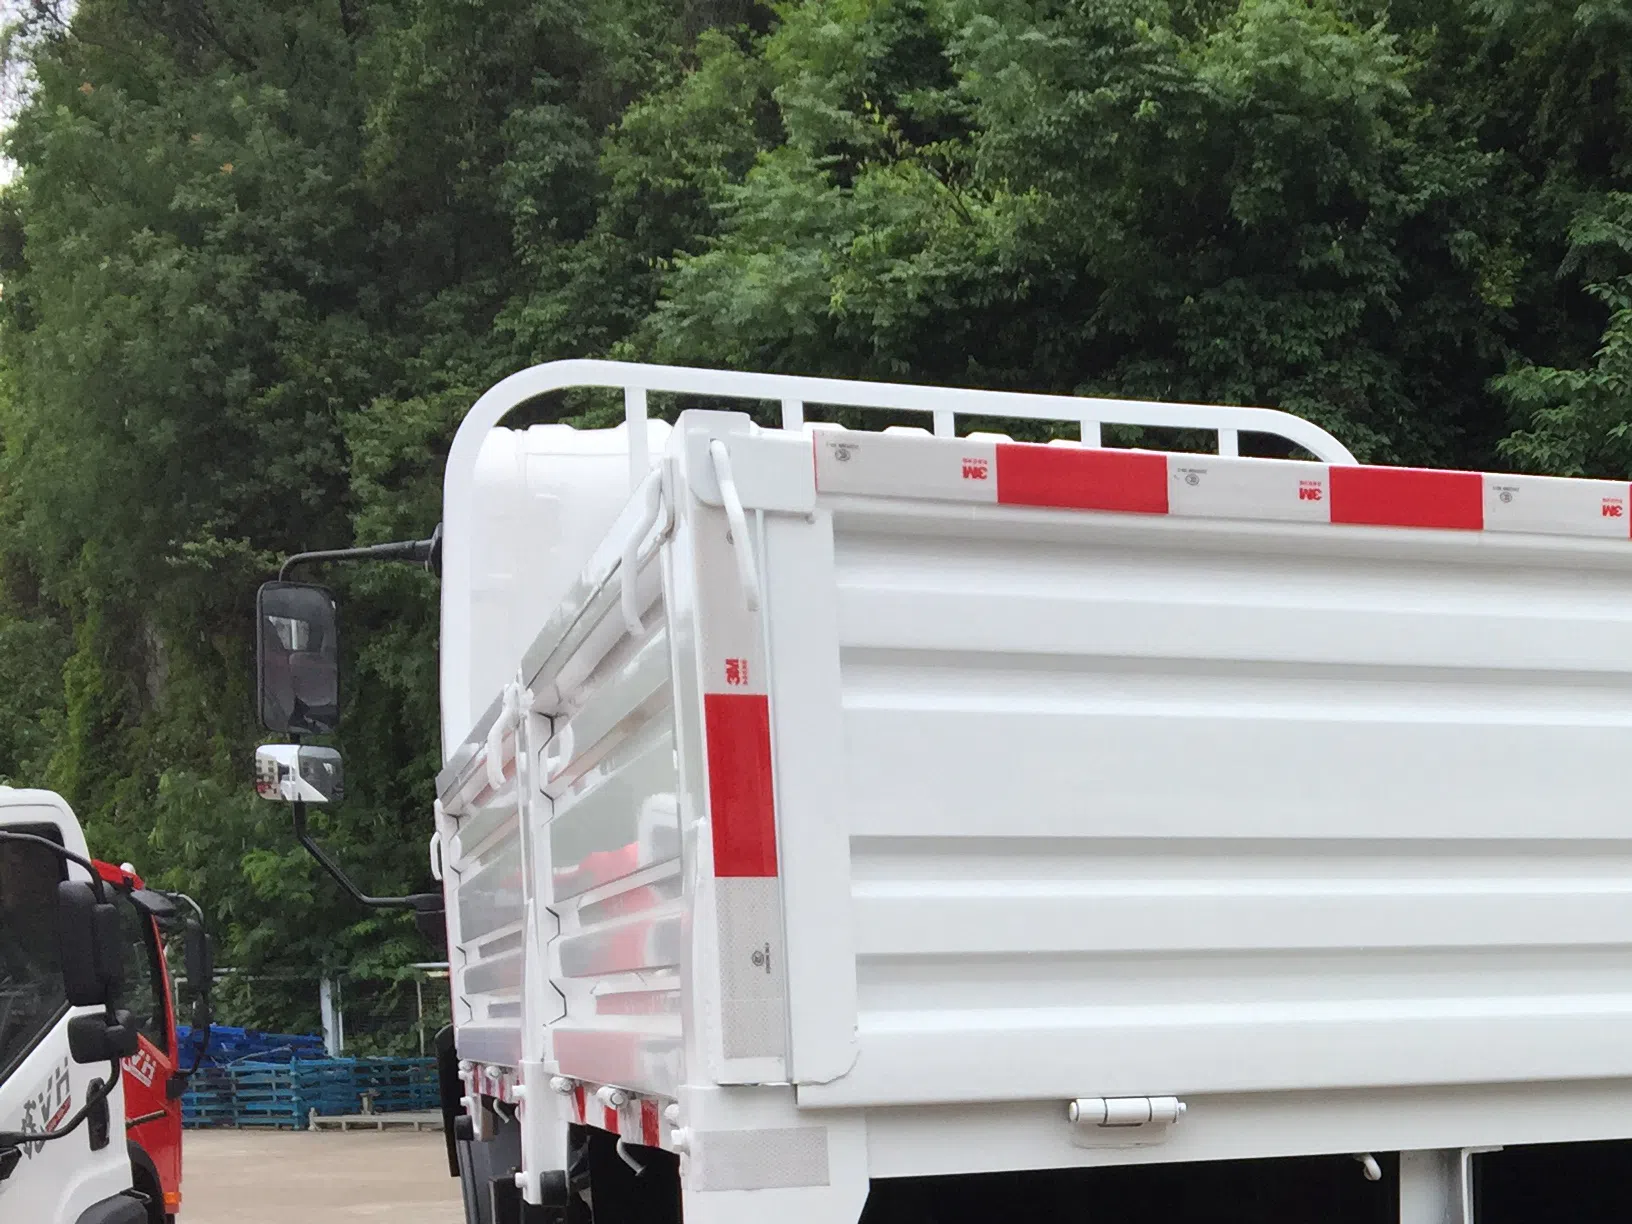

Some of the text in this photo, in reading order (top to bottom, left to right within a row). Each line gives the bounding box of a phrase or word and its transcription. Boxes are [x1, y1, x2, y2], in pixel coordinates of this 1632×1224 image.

[962, 466, 988, 480] 3M
[1299, 488, 1322, 501] 3M
[1601, 504, 1622, 518] 3M
[726, 659, 740, 686] 3M
